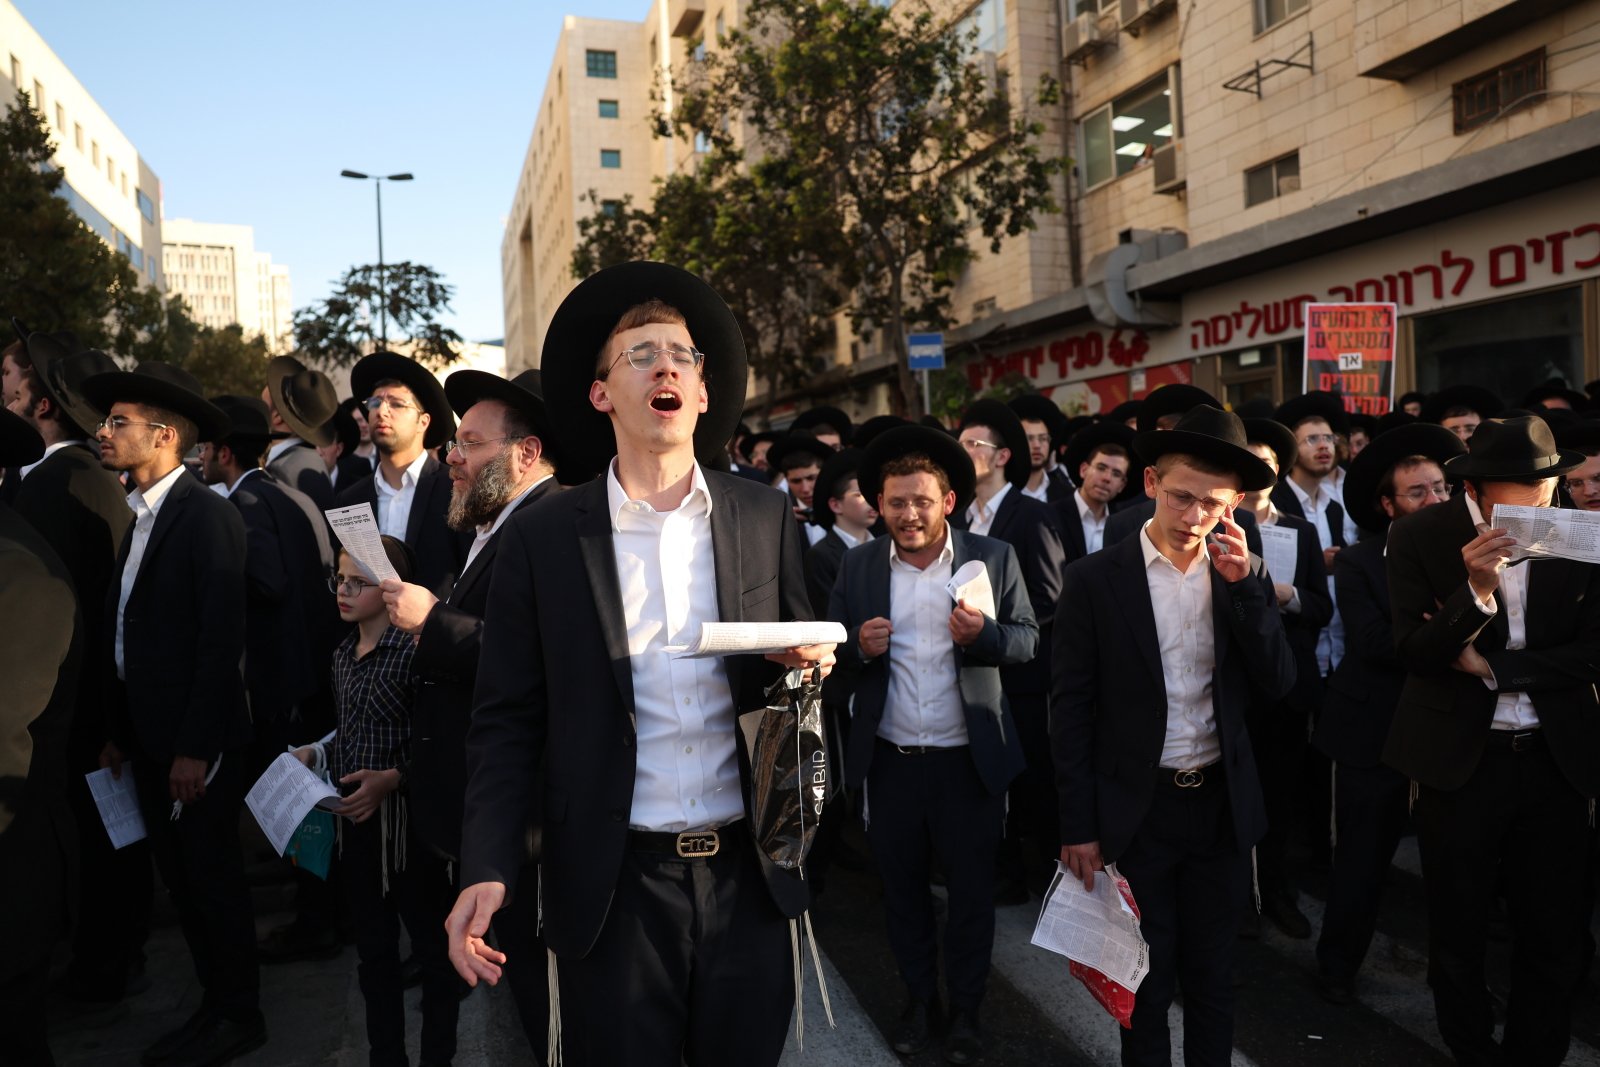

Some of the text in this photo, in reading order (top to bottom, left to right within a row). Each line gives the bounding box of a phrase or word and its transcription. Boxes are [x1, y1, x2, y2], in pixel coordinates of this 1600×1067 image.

[1371, 307, 1392, 327] לא
[1050, 331, 1103, 379] סניף
[1340, 354, 1360, 368] אך
